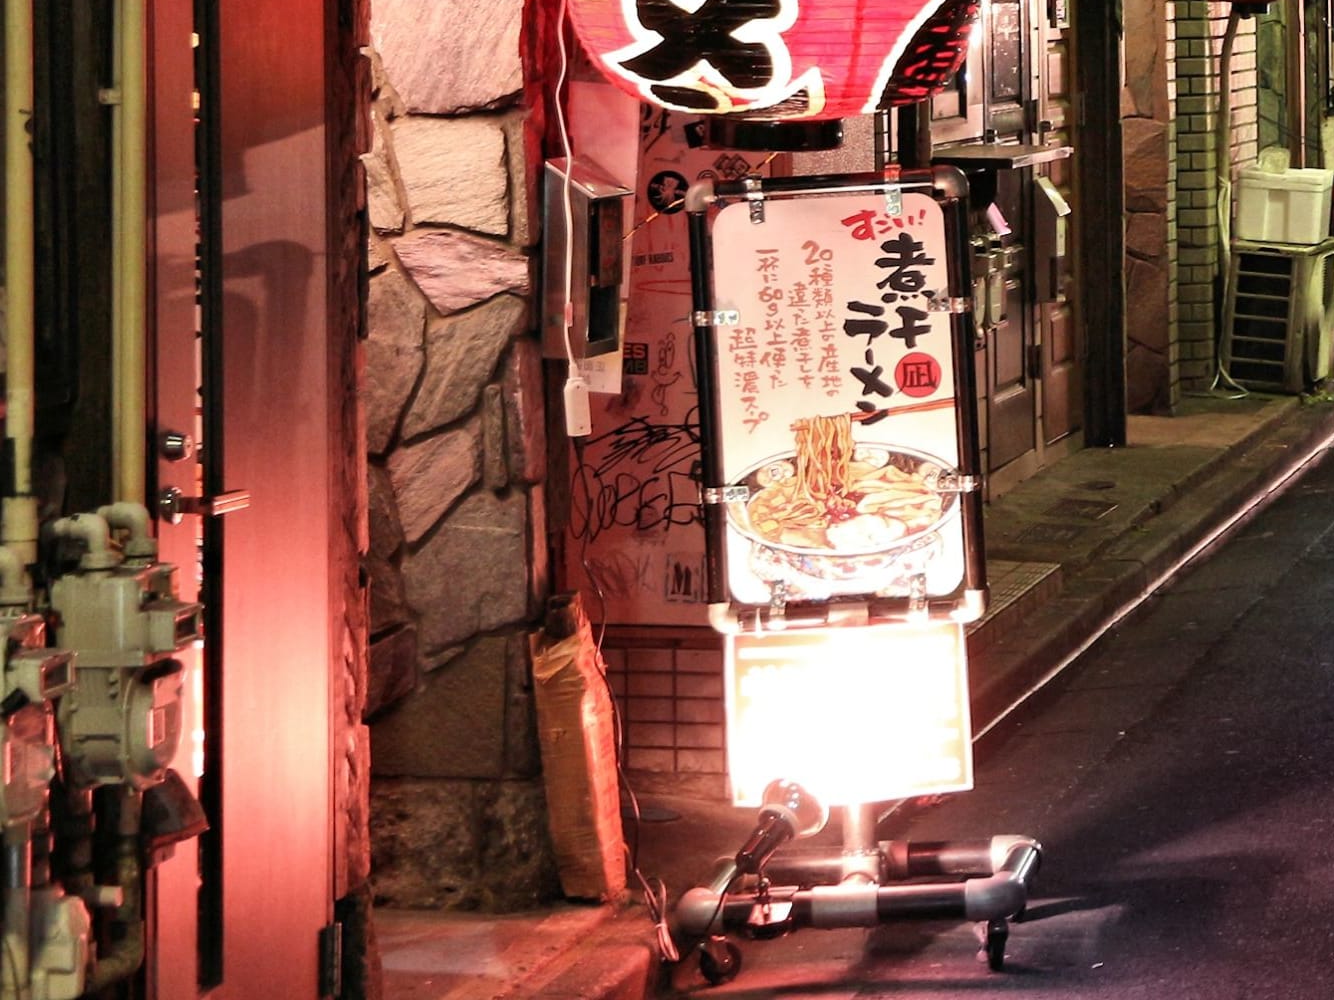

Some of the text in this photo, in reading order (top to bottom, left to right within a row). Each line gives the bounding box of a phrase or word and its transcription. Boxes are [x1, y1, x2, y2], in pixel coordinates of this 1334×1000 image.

[875, 233, 936, 348] 煮干
[844, 301, 894, 425] ラーメン
